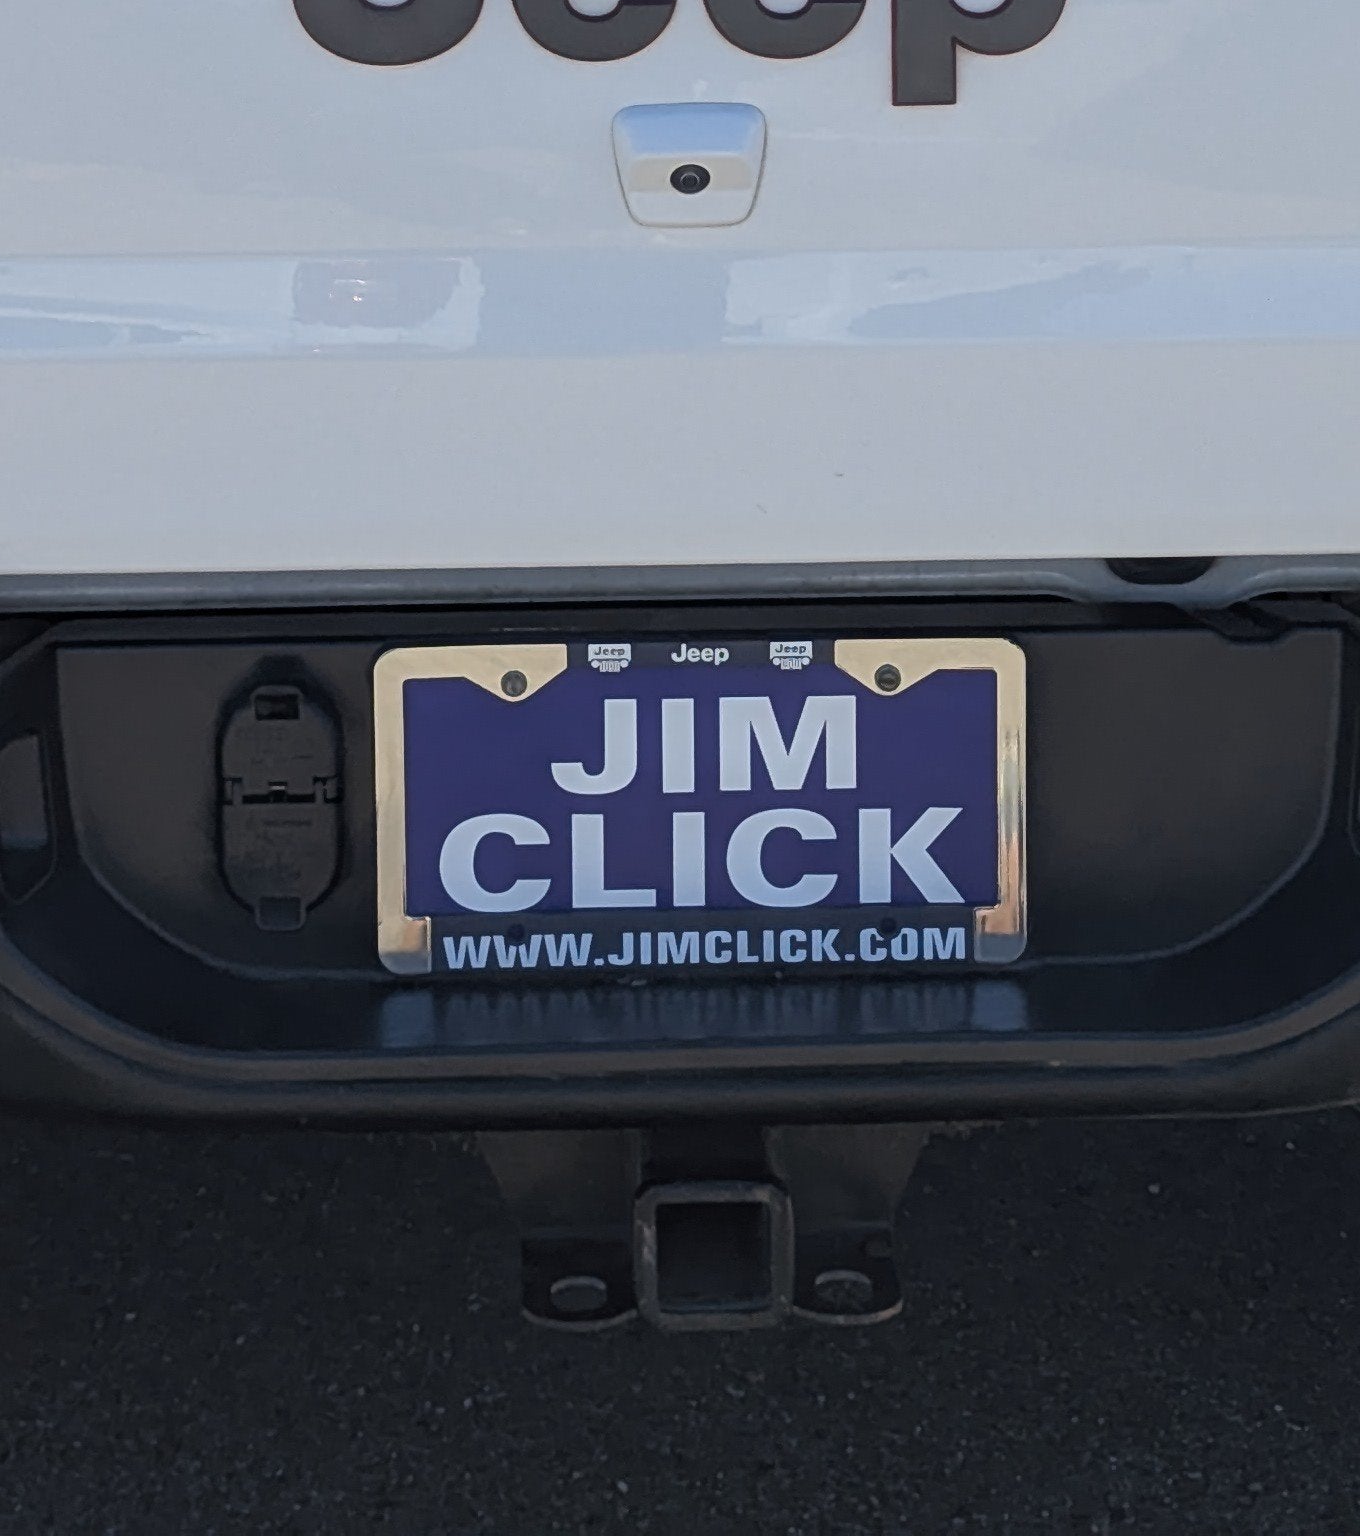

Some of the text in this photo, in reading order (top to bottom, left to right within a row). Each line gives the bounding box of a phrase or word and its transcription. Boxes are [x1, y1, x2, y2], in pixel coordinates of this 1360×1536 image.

[593, 645, 626, 656] Jeep
[671, 642, 730, 666] Jeep
[774, 642, 808, 654] Jeep
[550, 694, 858, 796] JIM
[439, 806, 966, 913] CLICK
[442, 926, 967, 970] WWW.JIMCLICK.COM
